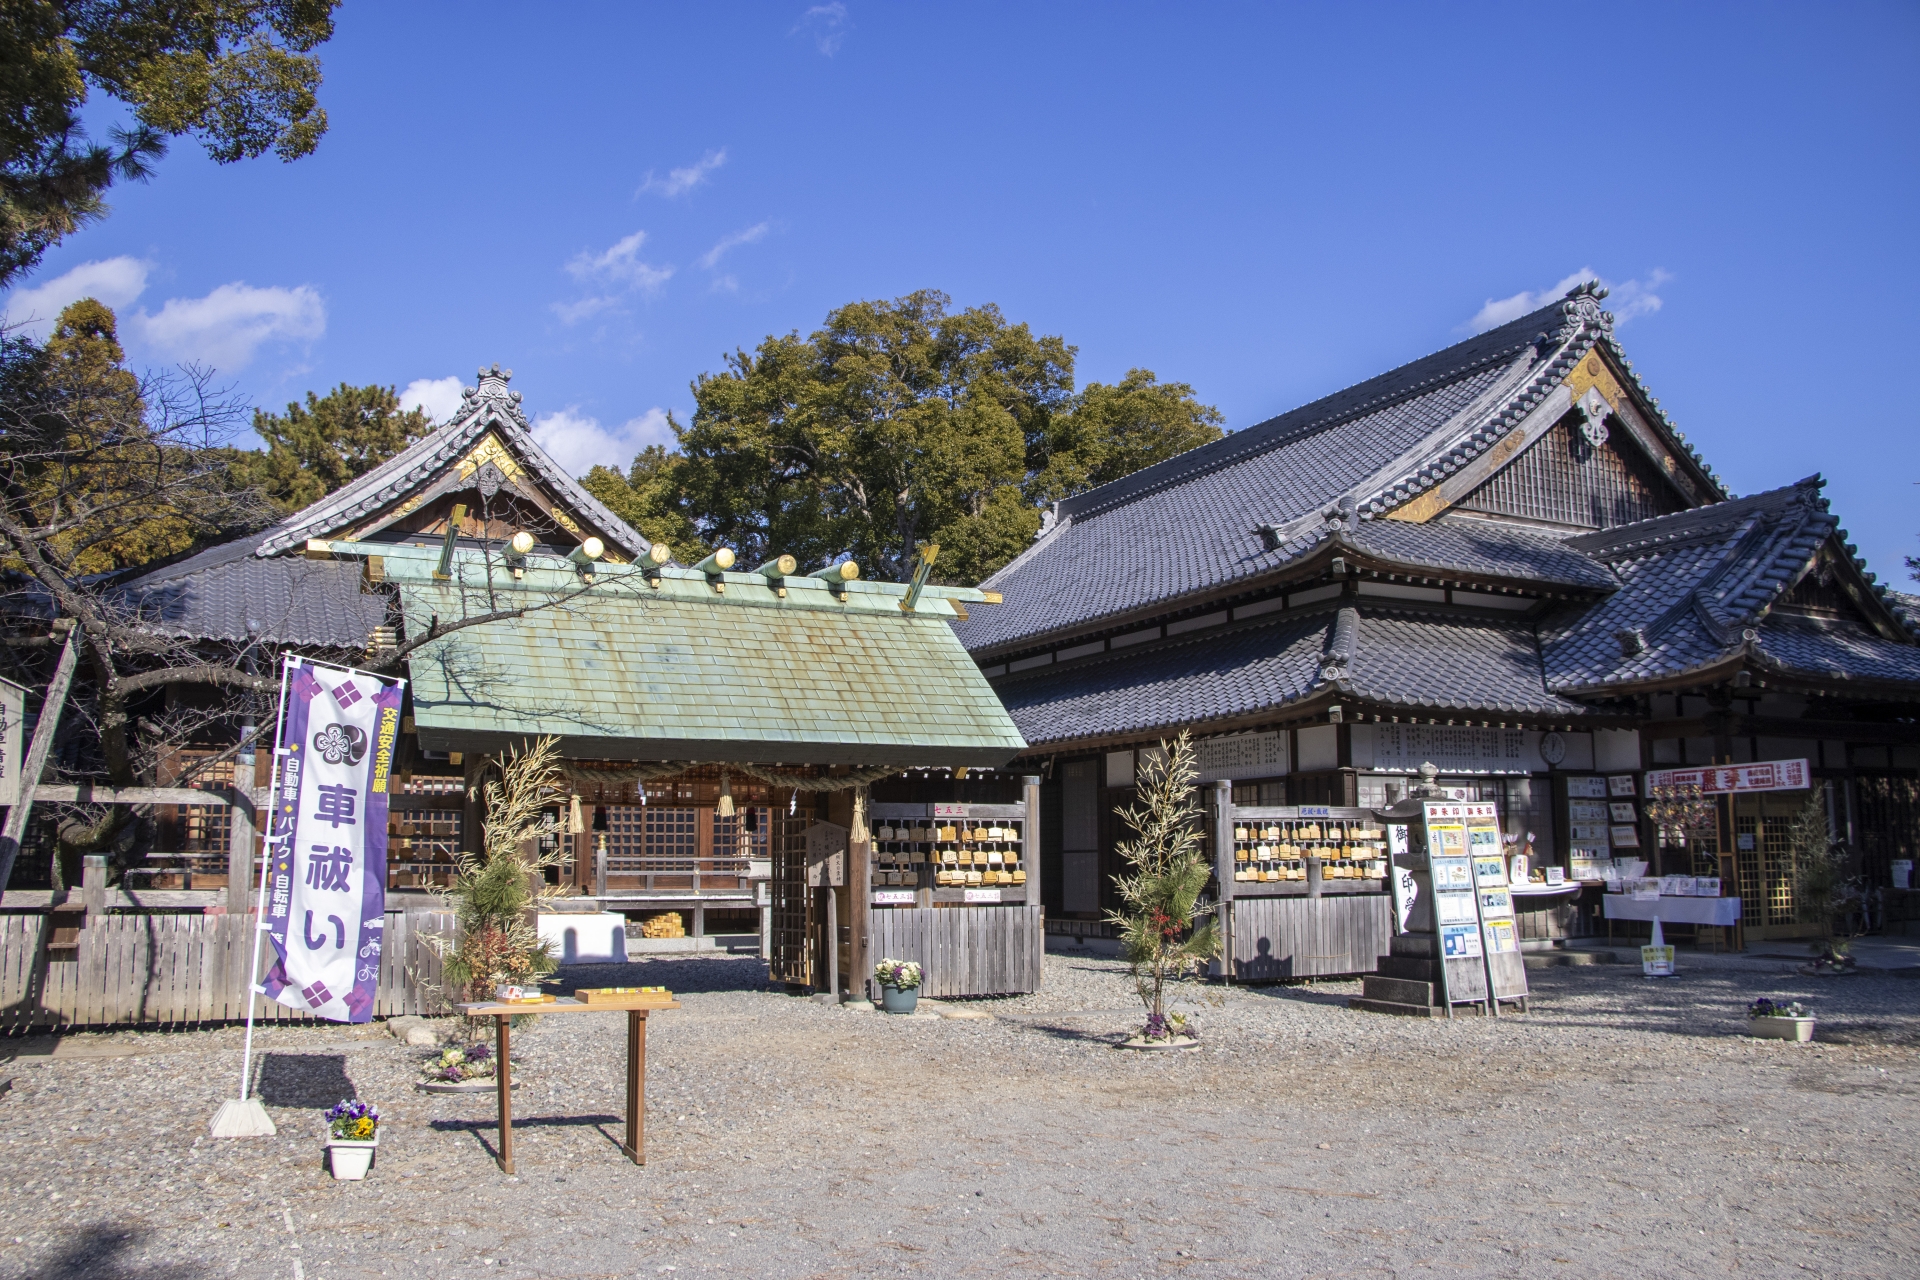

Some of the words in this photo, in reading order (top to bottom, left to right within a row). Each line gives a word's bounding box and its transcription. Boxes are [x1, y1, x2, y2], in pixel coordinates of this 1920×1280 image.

[371, 707, 398, 794] 交通安全祈願
[282, 757, 300, 802] 自動車
[934, 805, 964, 814] 七五三
[1429, 807, 1460, 816] 御朱印
[1467, 806, 1493, 816] 御朱印
[278, 816, 296, 859] バイク
[303, 783, 358, 950] 車祓い
[1395, 825, 1415, 912] 御印受
[271, 874, 290, 918] 自転車
